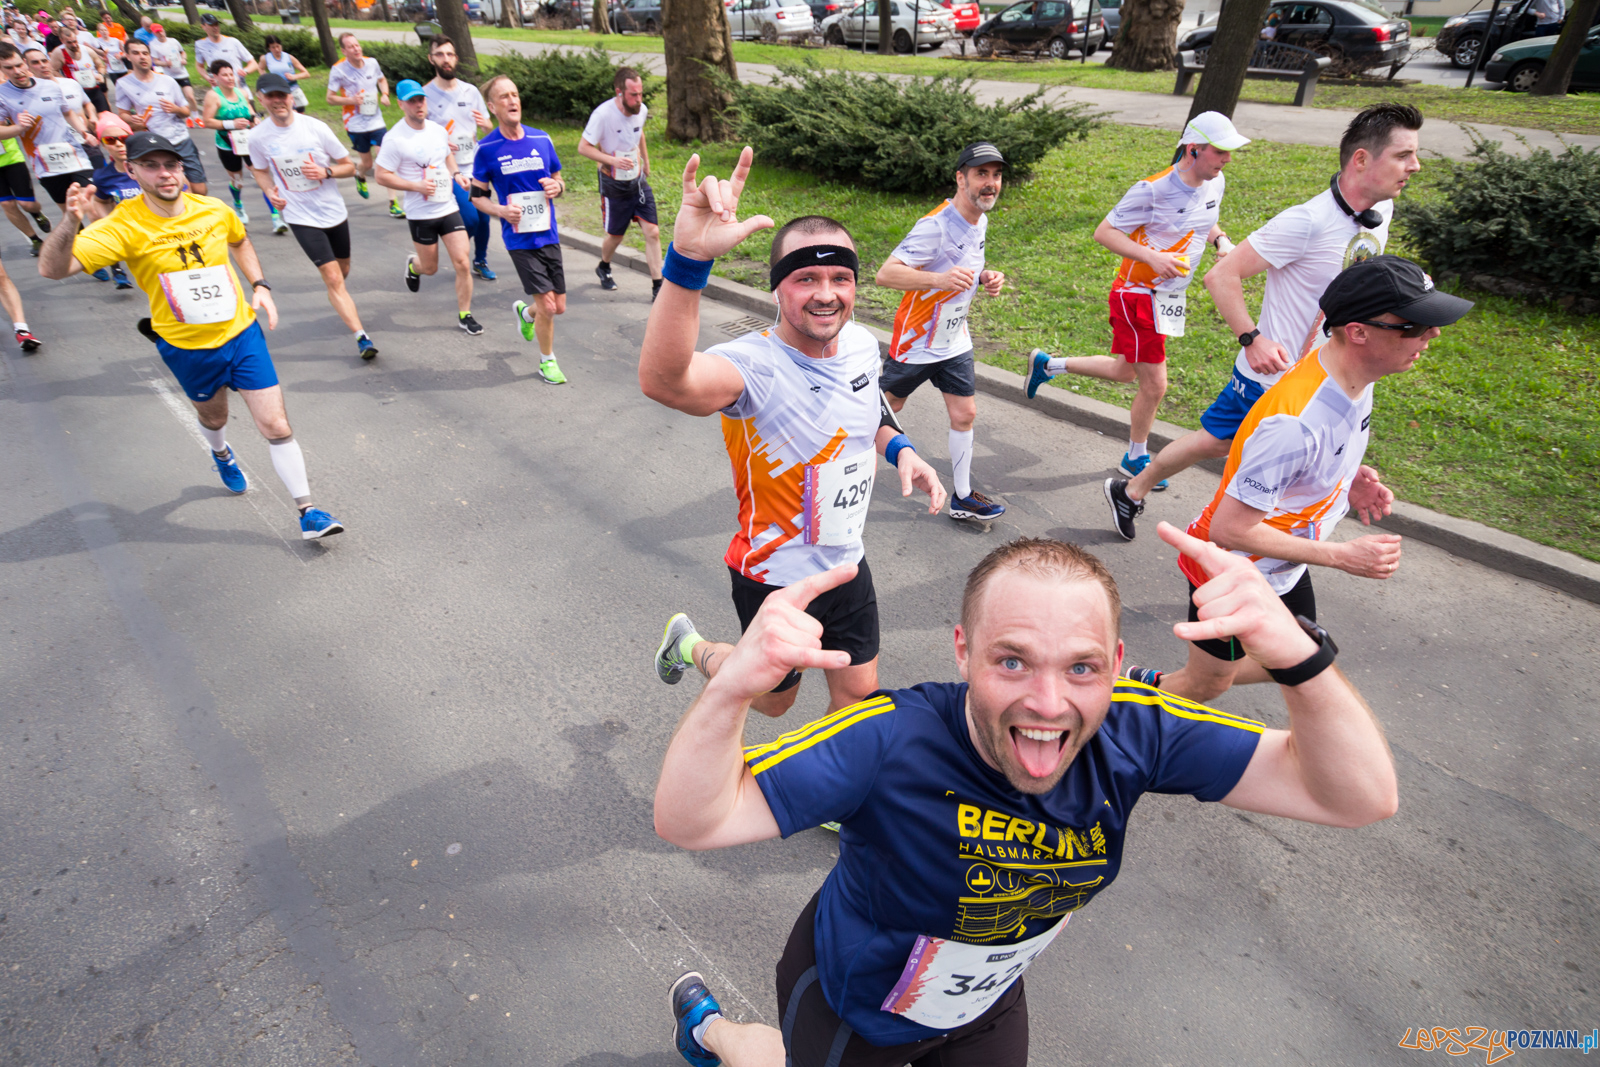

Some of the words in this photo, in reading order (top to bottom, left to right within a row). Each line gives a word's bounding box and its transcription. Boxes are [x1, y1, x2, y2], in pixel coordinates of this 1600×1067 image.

[48, 151, 71, 162] 5791
[281, 165, 303, 177] 108
[189, 284, 223, 301] 352
[1160, 304, 1187, 317] 268
[833, 475, 872, 510] 4291
[958, 803, 1093, 860] BERLIN
